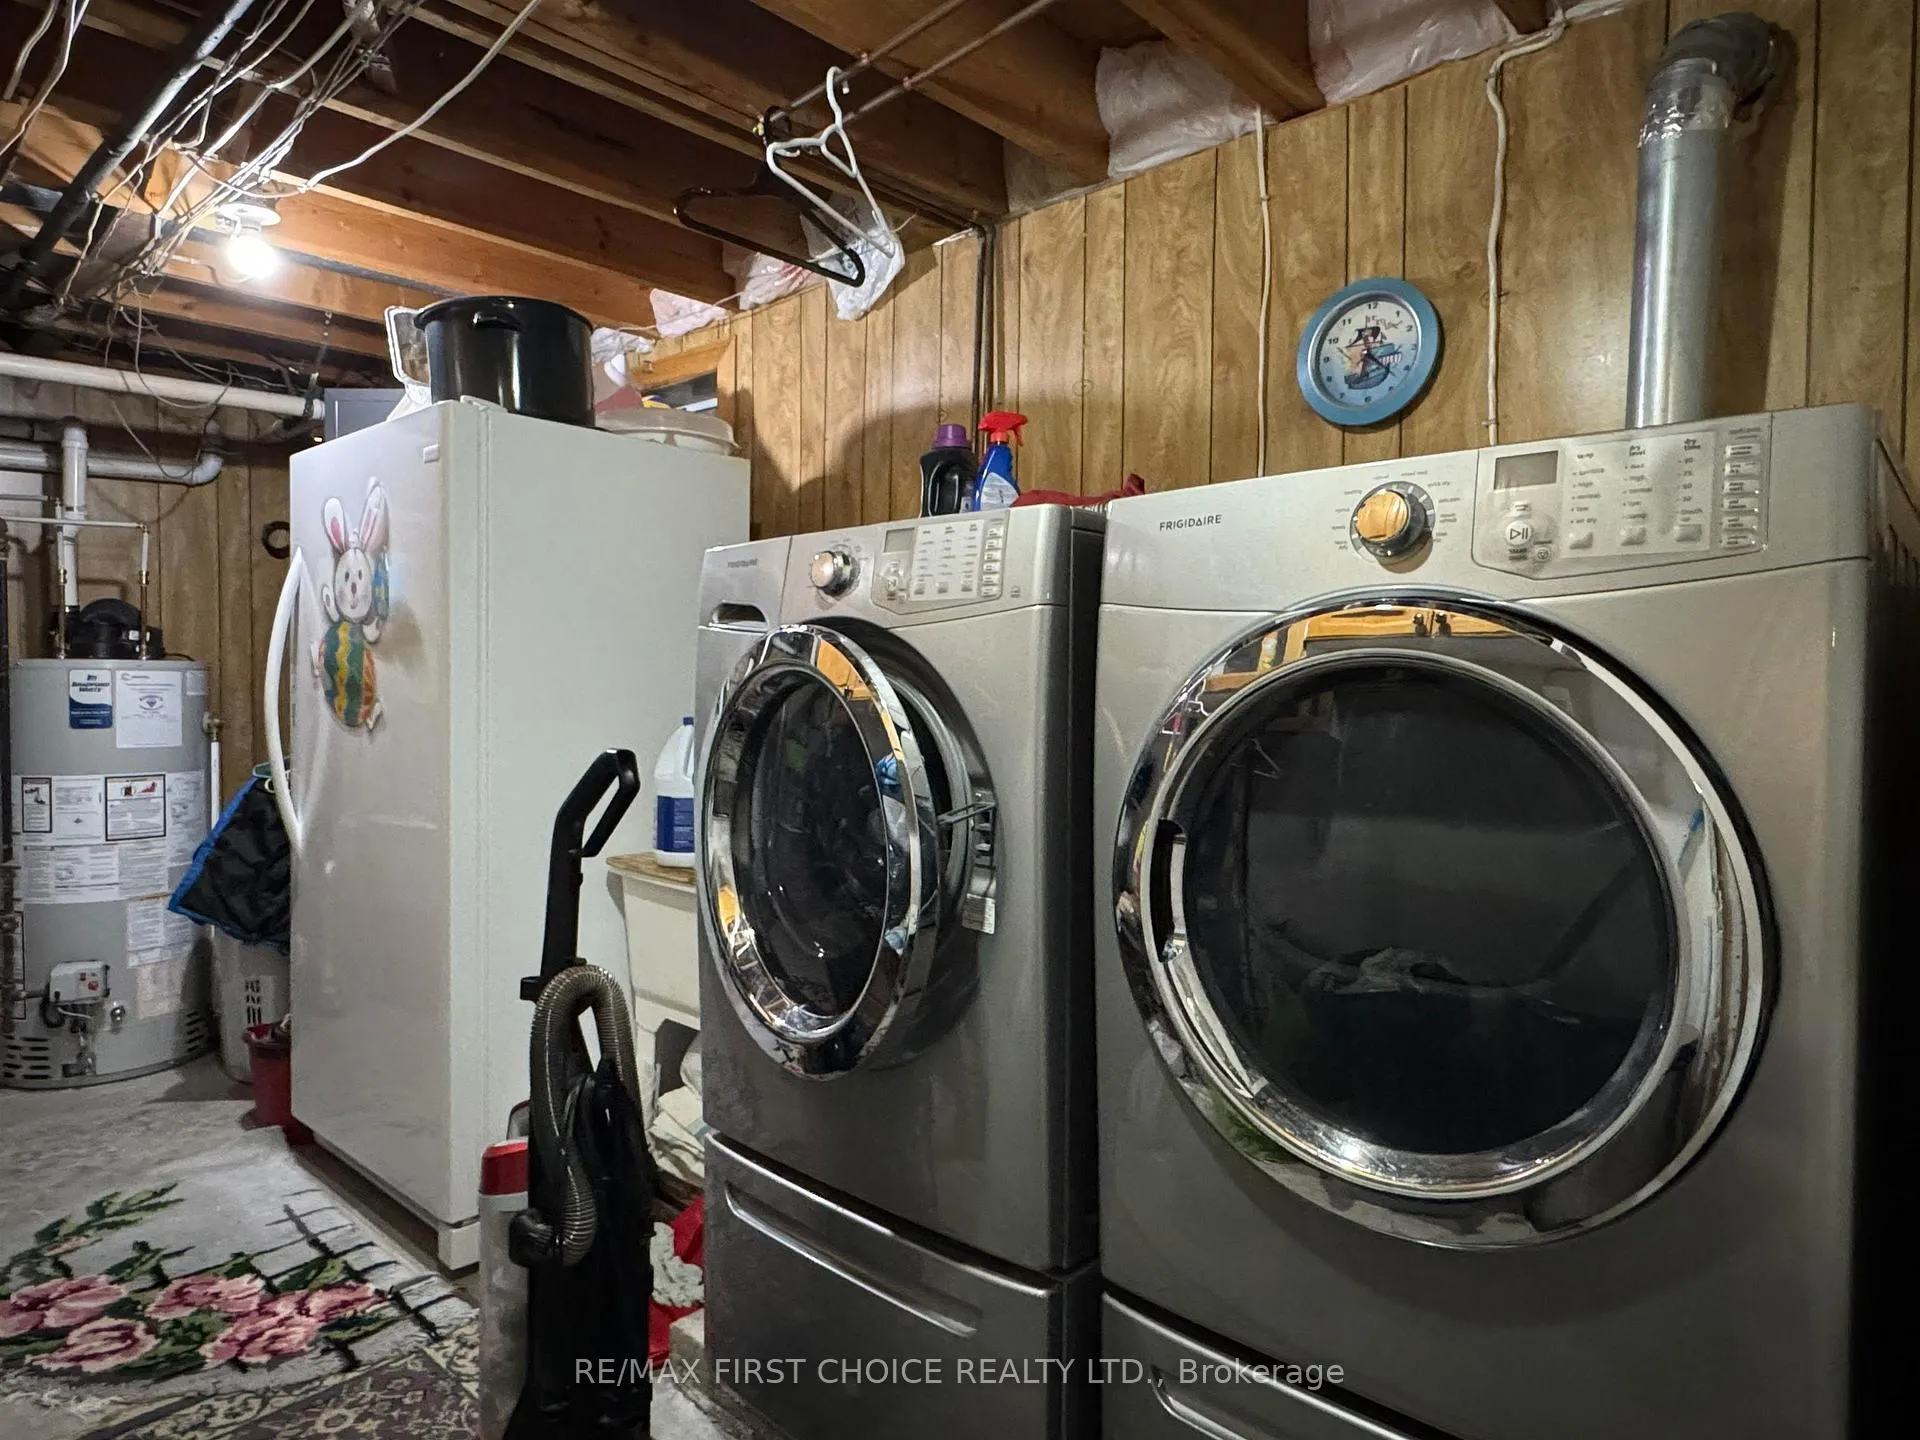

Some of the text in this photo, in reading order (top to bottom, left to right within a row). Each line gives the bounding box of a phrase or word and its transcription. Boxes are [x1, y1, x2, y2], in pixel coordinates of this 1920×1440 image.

[1367, 302, 1379, 310] 12
[1341, 318, 1352, 326] 11
[1327, 337, 1339, 345] 10
[1160, 514, 1223, 532] FRIGIDAIRE
